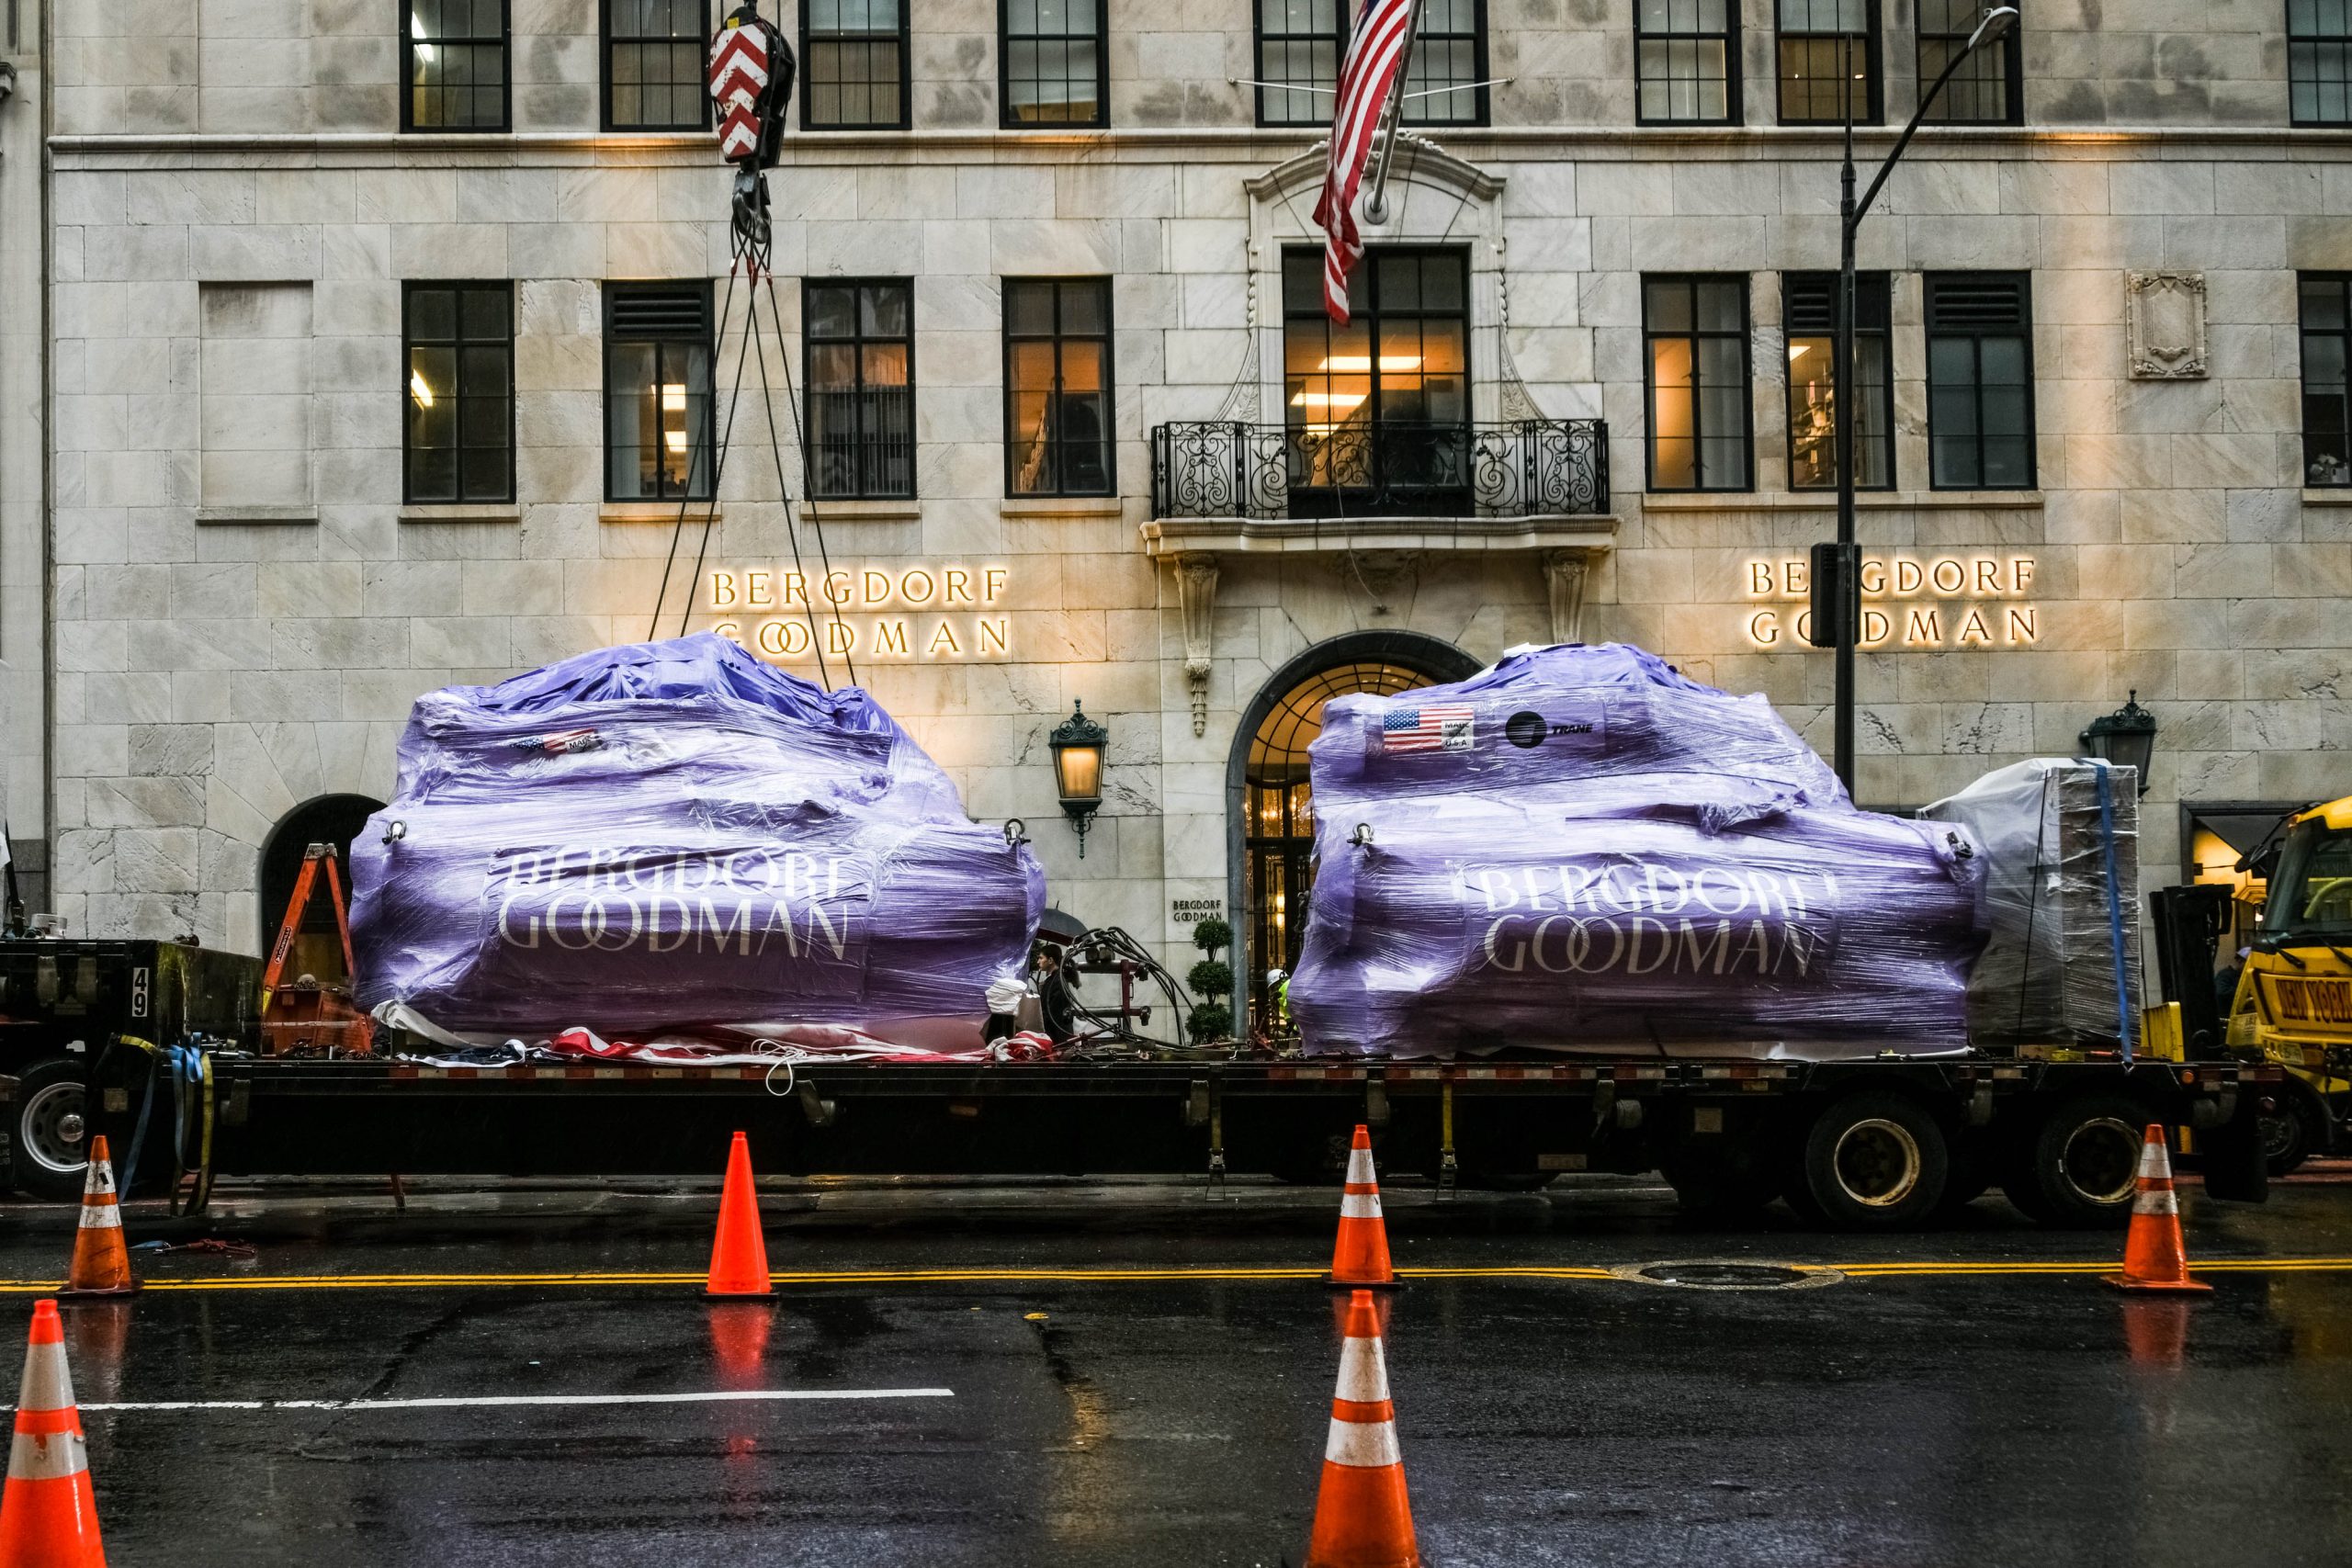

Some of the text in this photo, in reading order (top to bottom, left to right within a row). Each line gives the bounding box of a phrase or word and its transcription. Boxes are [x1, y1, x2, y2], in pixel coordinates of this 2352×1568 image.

[711, 570, 1008, 605] BERGDORF
[1750, 559, 2035, 593] BEGDORF
[1750, 608, 2036, 644] GDMAN
[1552, 723, 1593, 735] TRANE
[504, 844, 854, 901] BERGDORF
[1173, 899, 1221, 910] BERGDORF
[1478, 863, 1816, 920] BERGDORF
[498, 891, 850, 961] GOODMAN
[1173, 911, 1222, 921] GOODMAN
[1483, 913, 1817, 976] GOODMAN
[2275, 979, 2352, 1023] NEW YORK
